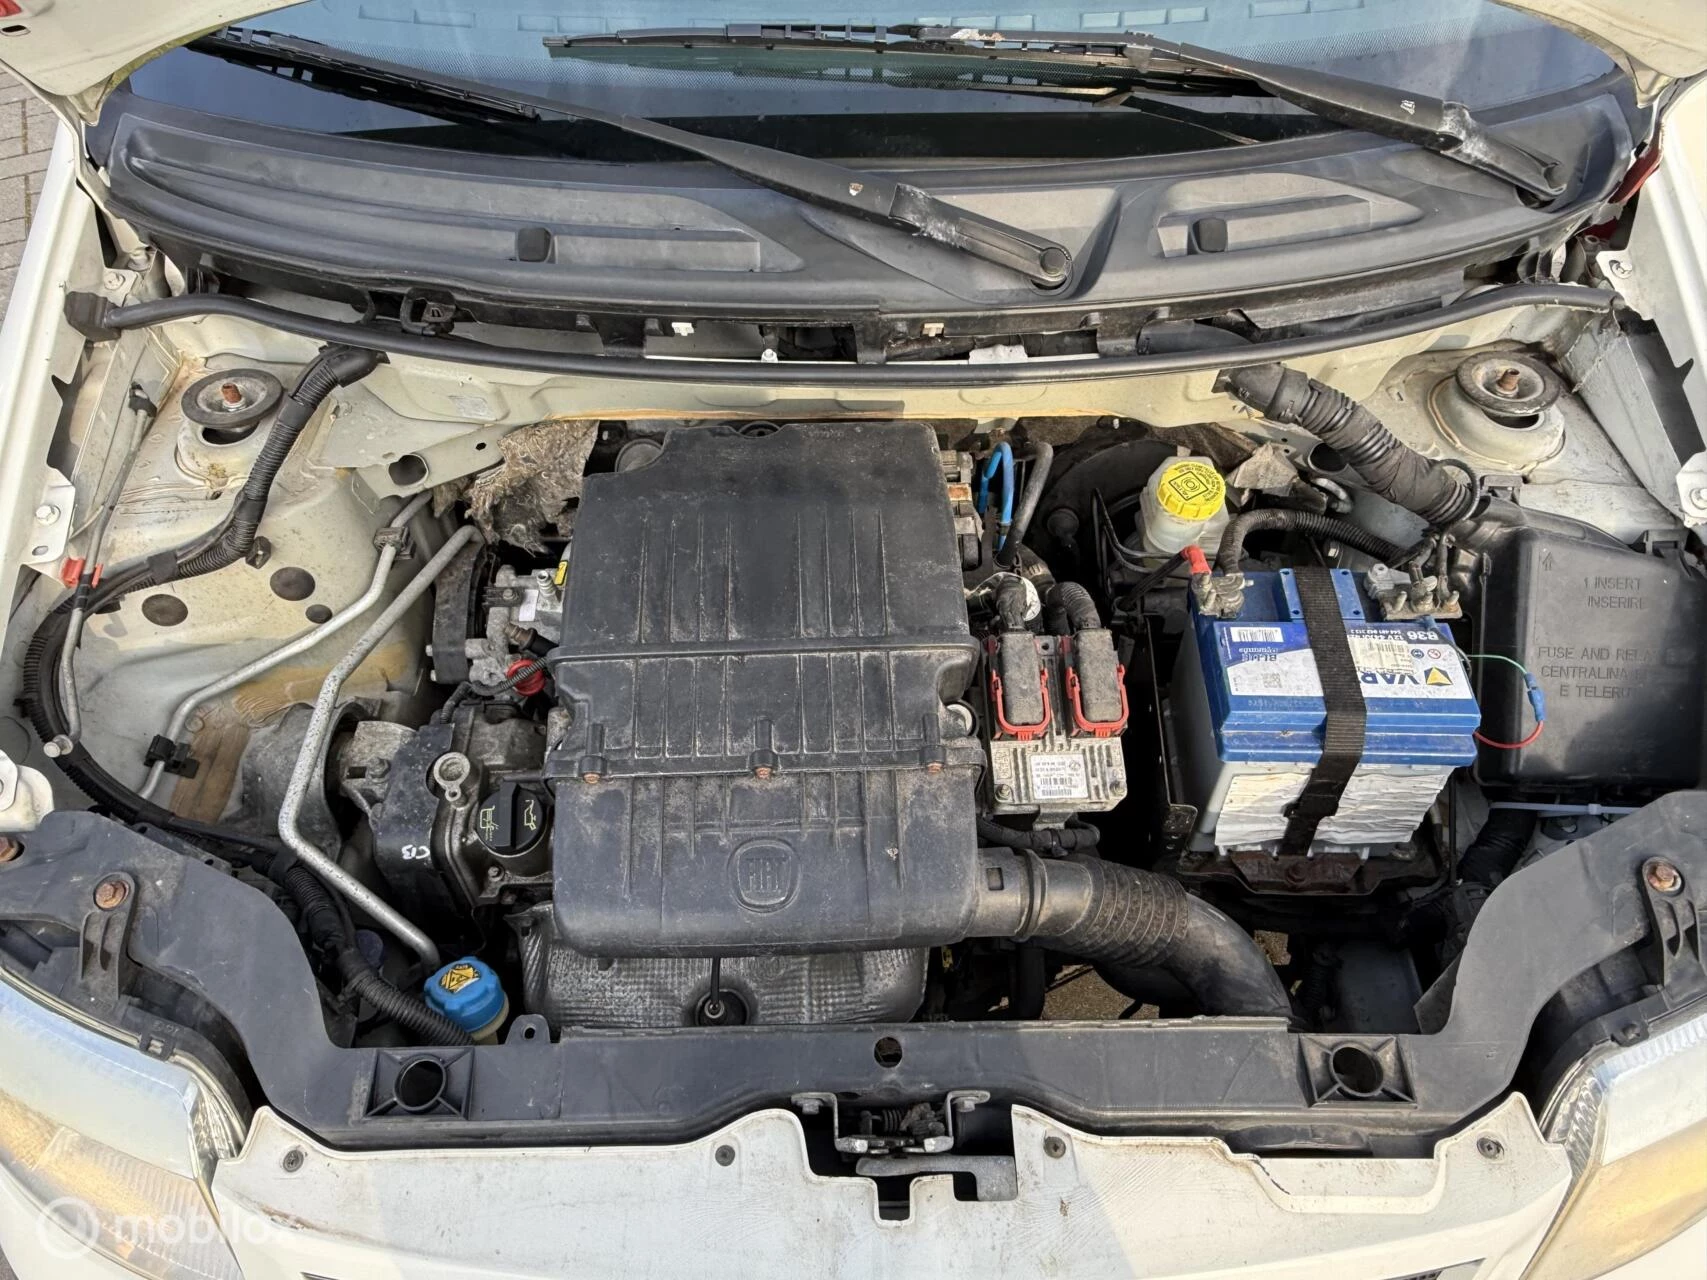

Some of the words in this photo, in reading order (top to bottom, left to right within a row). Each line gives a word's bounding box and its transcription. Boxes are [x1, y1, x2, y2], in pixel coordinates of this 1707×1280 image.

[1594, 577, 1641, 591] INSERT
[1407, 630, 1439, 641] B36
[1537, 647, 1575, 660] FUSE
[1580, 648, 1610, 661] AND
[1360, 671, 1420, 685] VAR
[1541, 665, 1630, 680] CENTRALINA
[1560, 684, 1569, 698] E
[745, 858, 788, 894] FIAT
